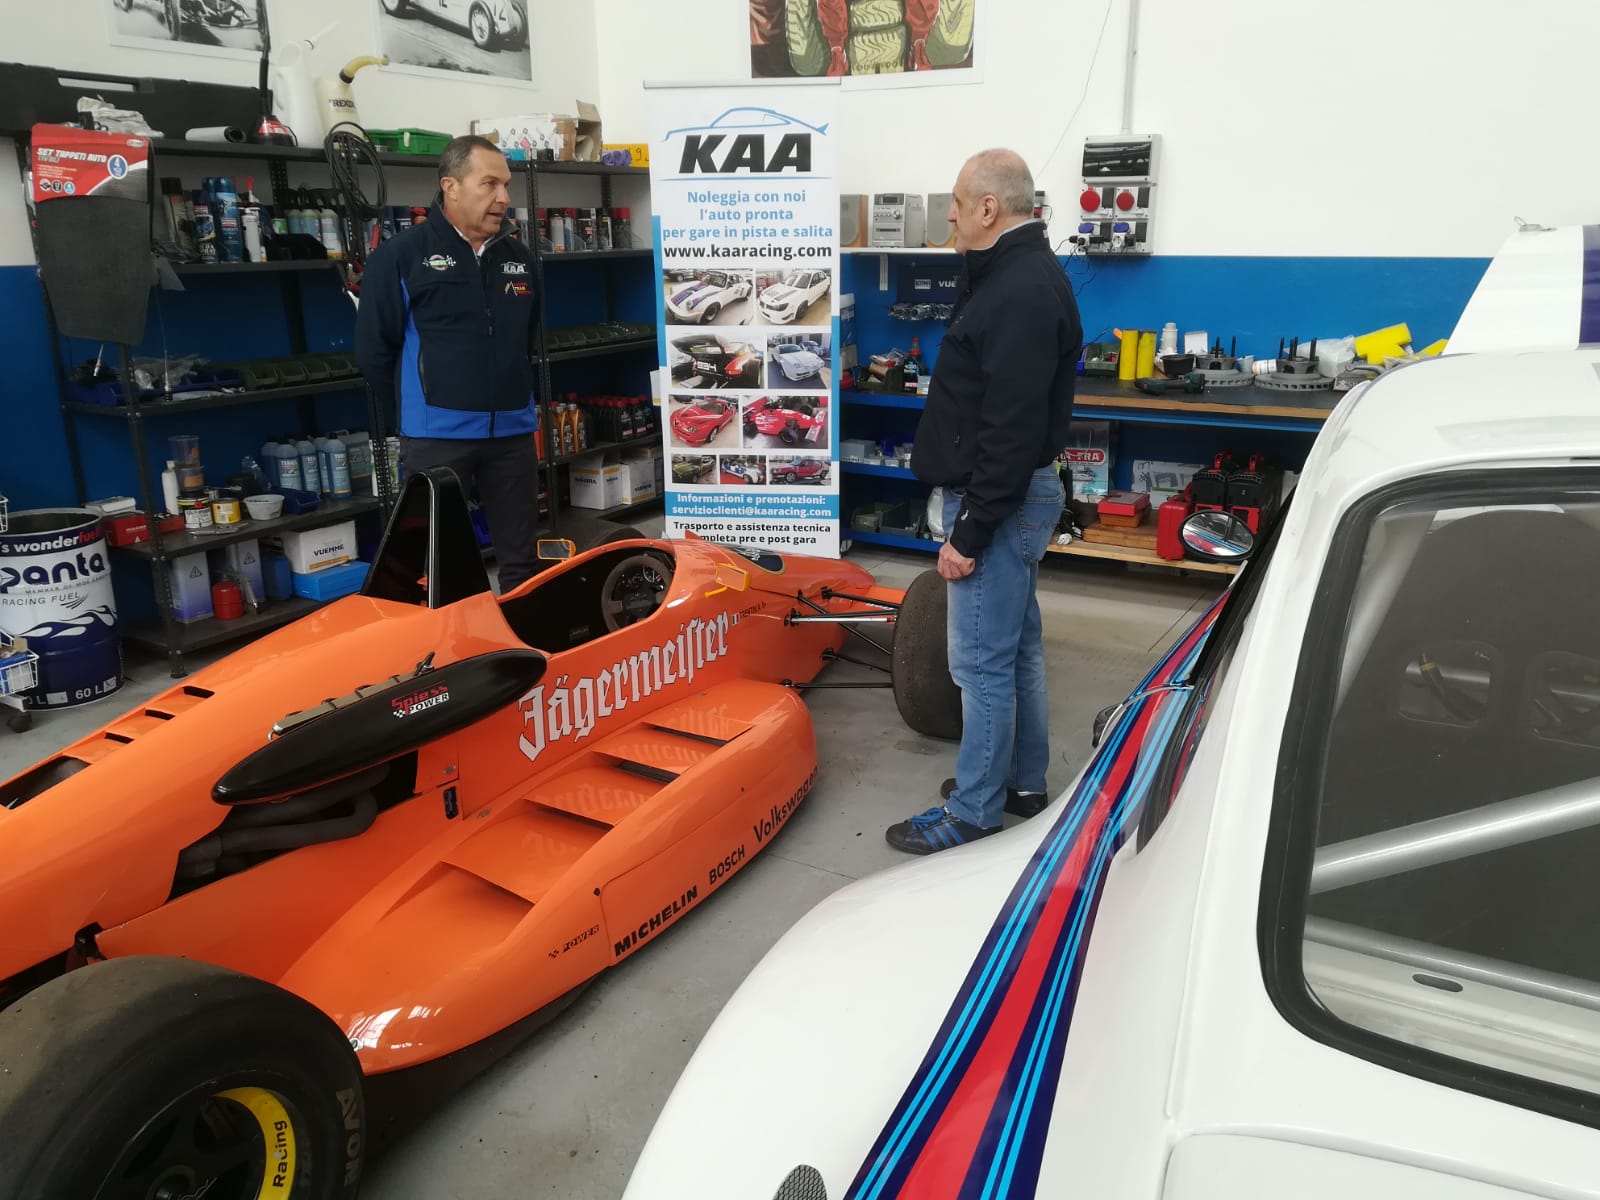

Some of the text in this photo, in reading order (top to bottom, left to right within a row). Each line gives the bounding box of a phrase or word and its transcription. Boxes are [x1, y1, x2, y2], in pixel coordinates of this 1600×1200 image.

[37, 148, 52, 156] SET
[87, 153, 107, 163] AUTO
[679, 133, 811, 174] KAA
[687, 190, 806, 206] Noleggia con noi
[700, 208, 793, 223] l'auto pronta
[663, 226, 832, 241] per gare in pista e salita
[664, 244, 832, 260] www.kaaracing.com
[677, 494, 744, 503] Informazioni
[756, 495, 826, 505] prenotazioni:
[672, 505, 832, 518] servizioclienti@kaaracing.com
[673, 521, 724, 532] Trasporto
[735, 522, 790, 531] assistenza
[793, 523, 831, 532] tecnica
[700, 534, 736, 542] mpleta
[739, 535, 756, 544] pre
[768, 535, 790, 545] post
[793, 536, 816, 545] gara
[51, 591, 80, 604] FUEL
[75, 684, 103, 700] 60 L
[391, 686, 448, 716] Spiess
[409, 692, 449, 712] POWER
[753, 765, 818, 843] Volkswagen
[708, 844, 746, 885] BOSCH
[614, 885, 698, 957] MICHELIN
[272, 1120, 288, 1188] Racing
